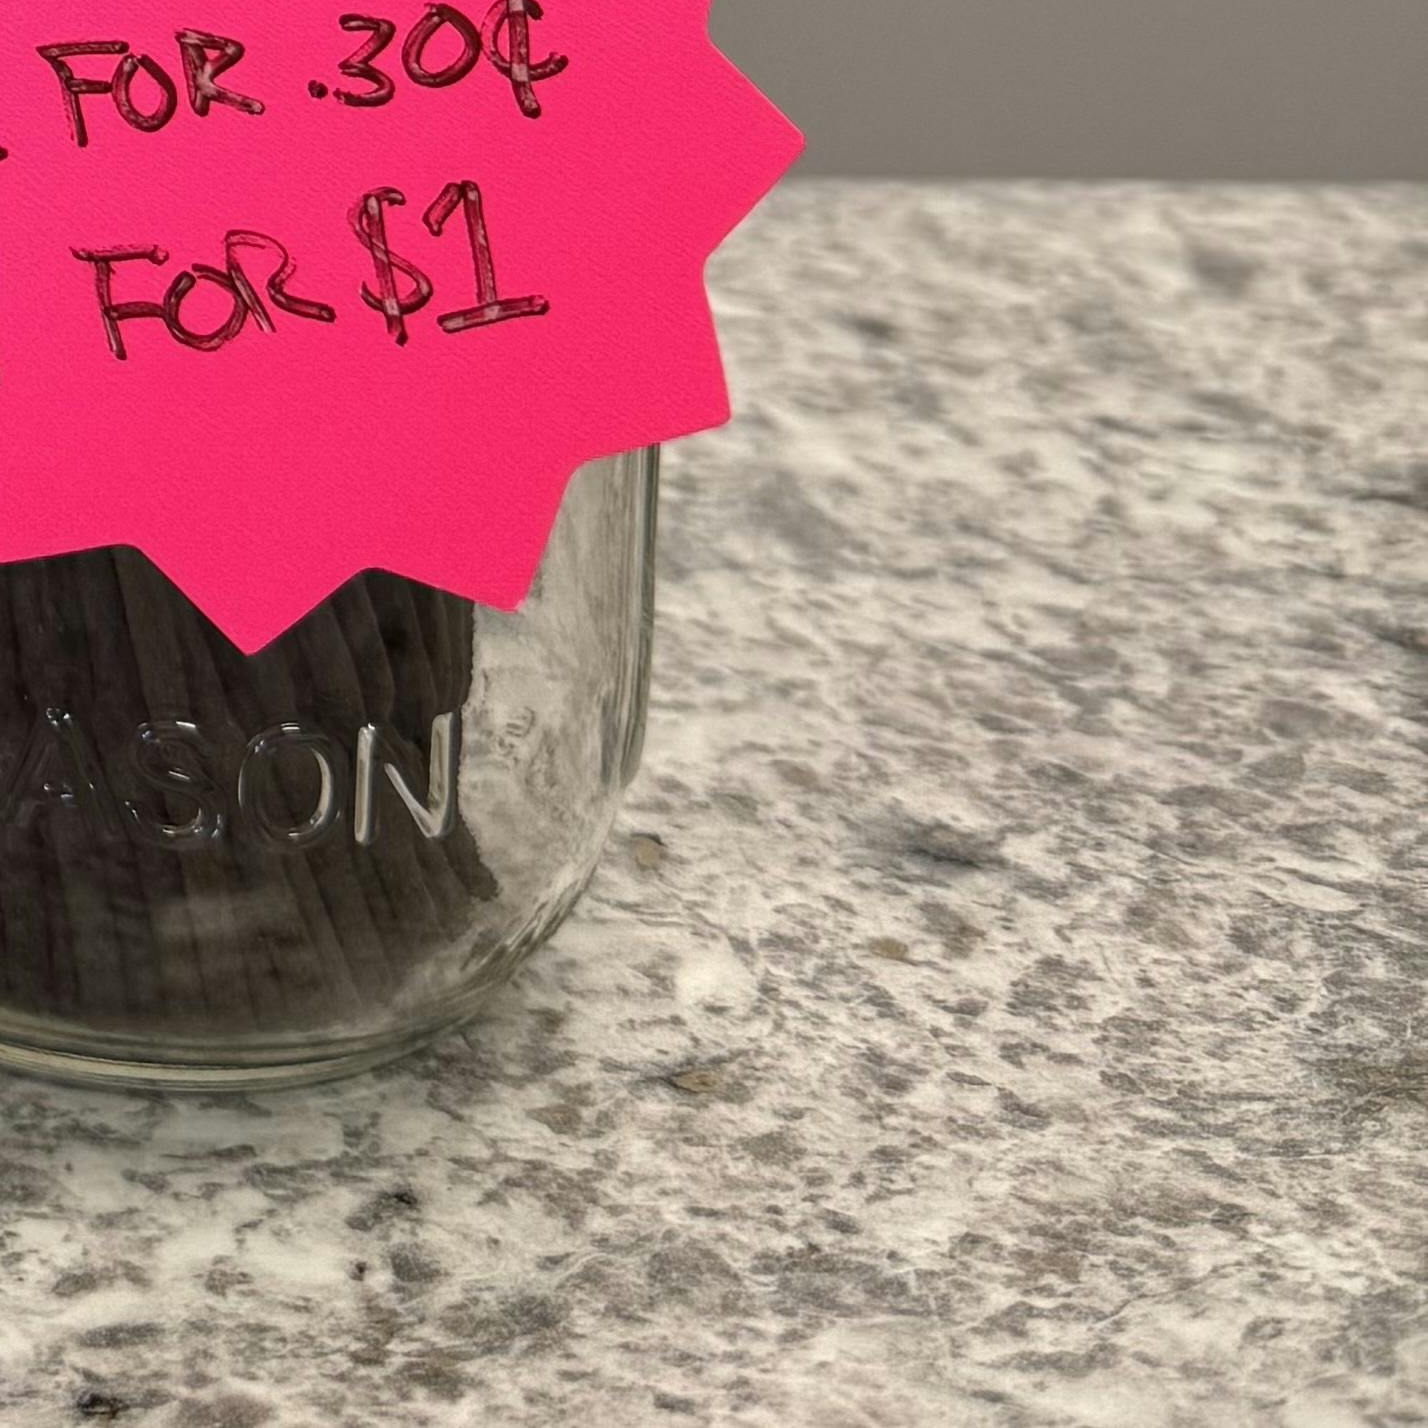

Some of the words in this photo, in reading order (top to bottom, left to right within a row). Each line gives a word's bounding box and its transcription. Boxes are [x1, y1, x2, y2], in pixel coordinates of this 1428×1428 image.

[36, 28, 265, 148] FOR
[71, 230, 336, 361] FOR
[353, 180, 550, 347] $1
